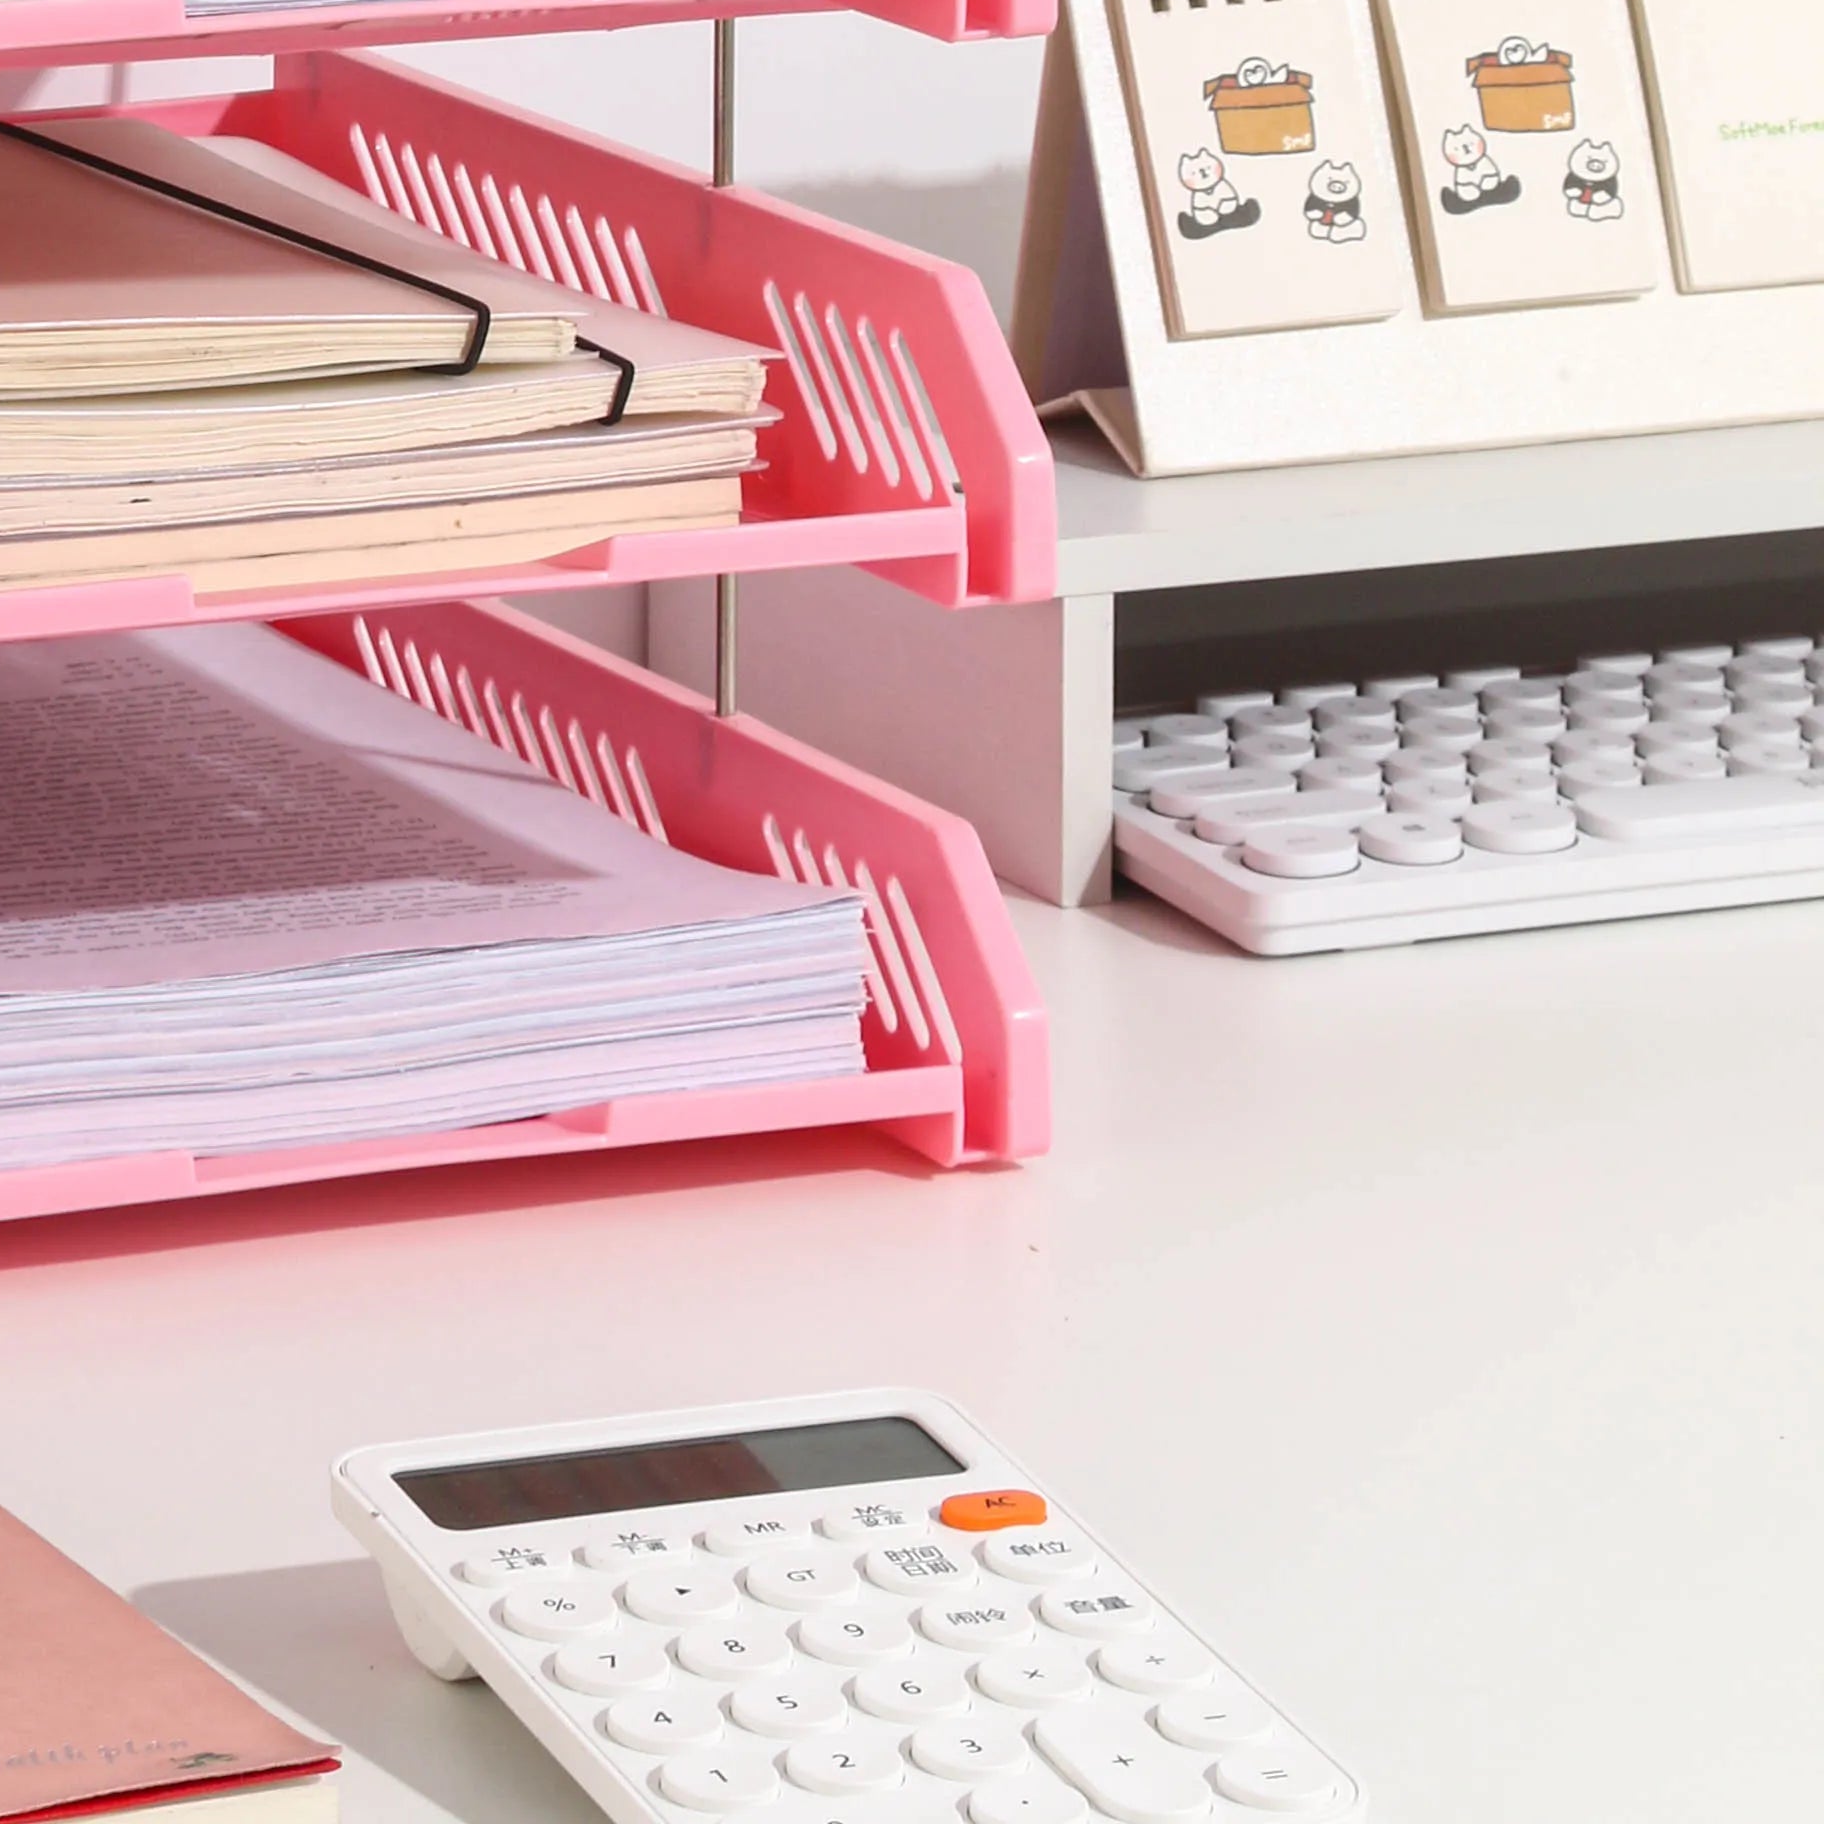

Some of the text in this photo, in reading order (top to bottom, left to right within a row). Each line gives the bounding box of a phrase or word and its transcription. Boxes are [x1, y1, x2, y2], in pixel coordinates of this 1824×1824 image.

[984, 1495, 1017, 1510] AC
[743, 1519, 787, 1535] MR
[884, 1545, 945, 1563] 时间
[543, 1567, 817, 1613] % GT
[599, 1622, 865, 1670] 7 8 9
[653, 1680, 922, 1726] 4 5 6
[709, 1738, 983, 1784] 1 2 3
